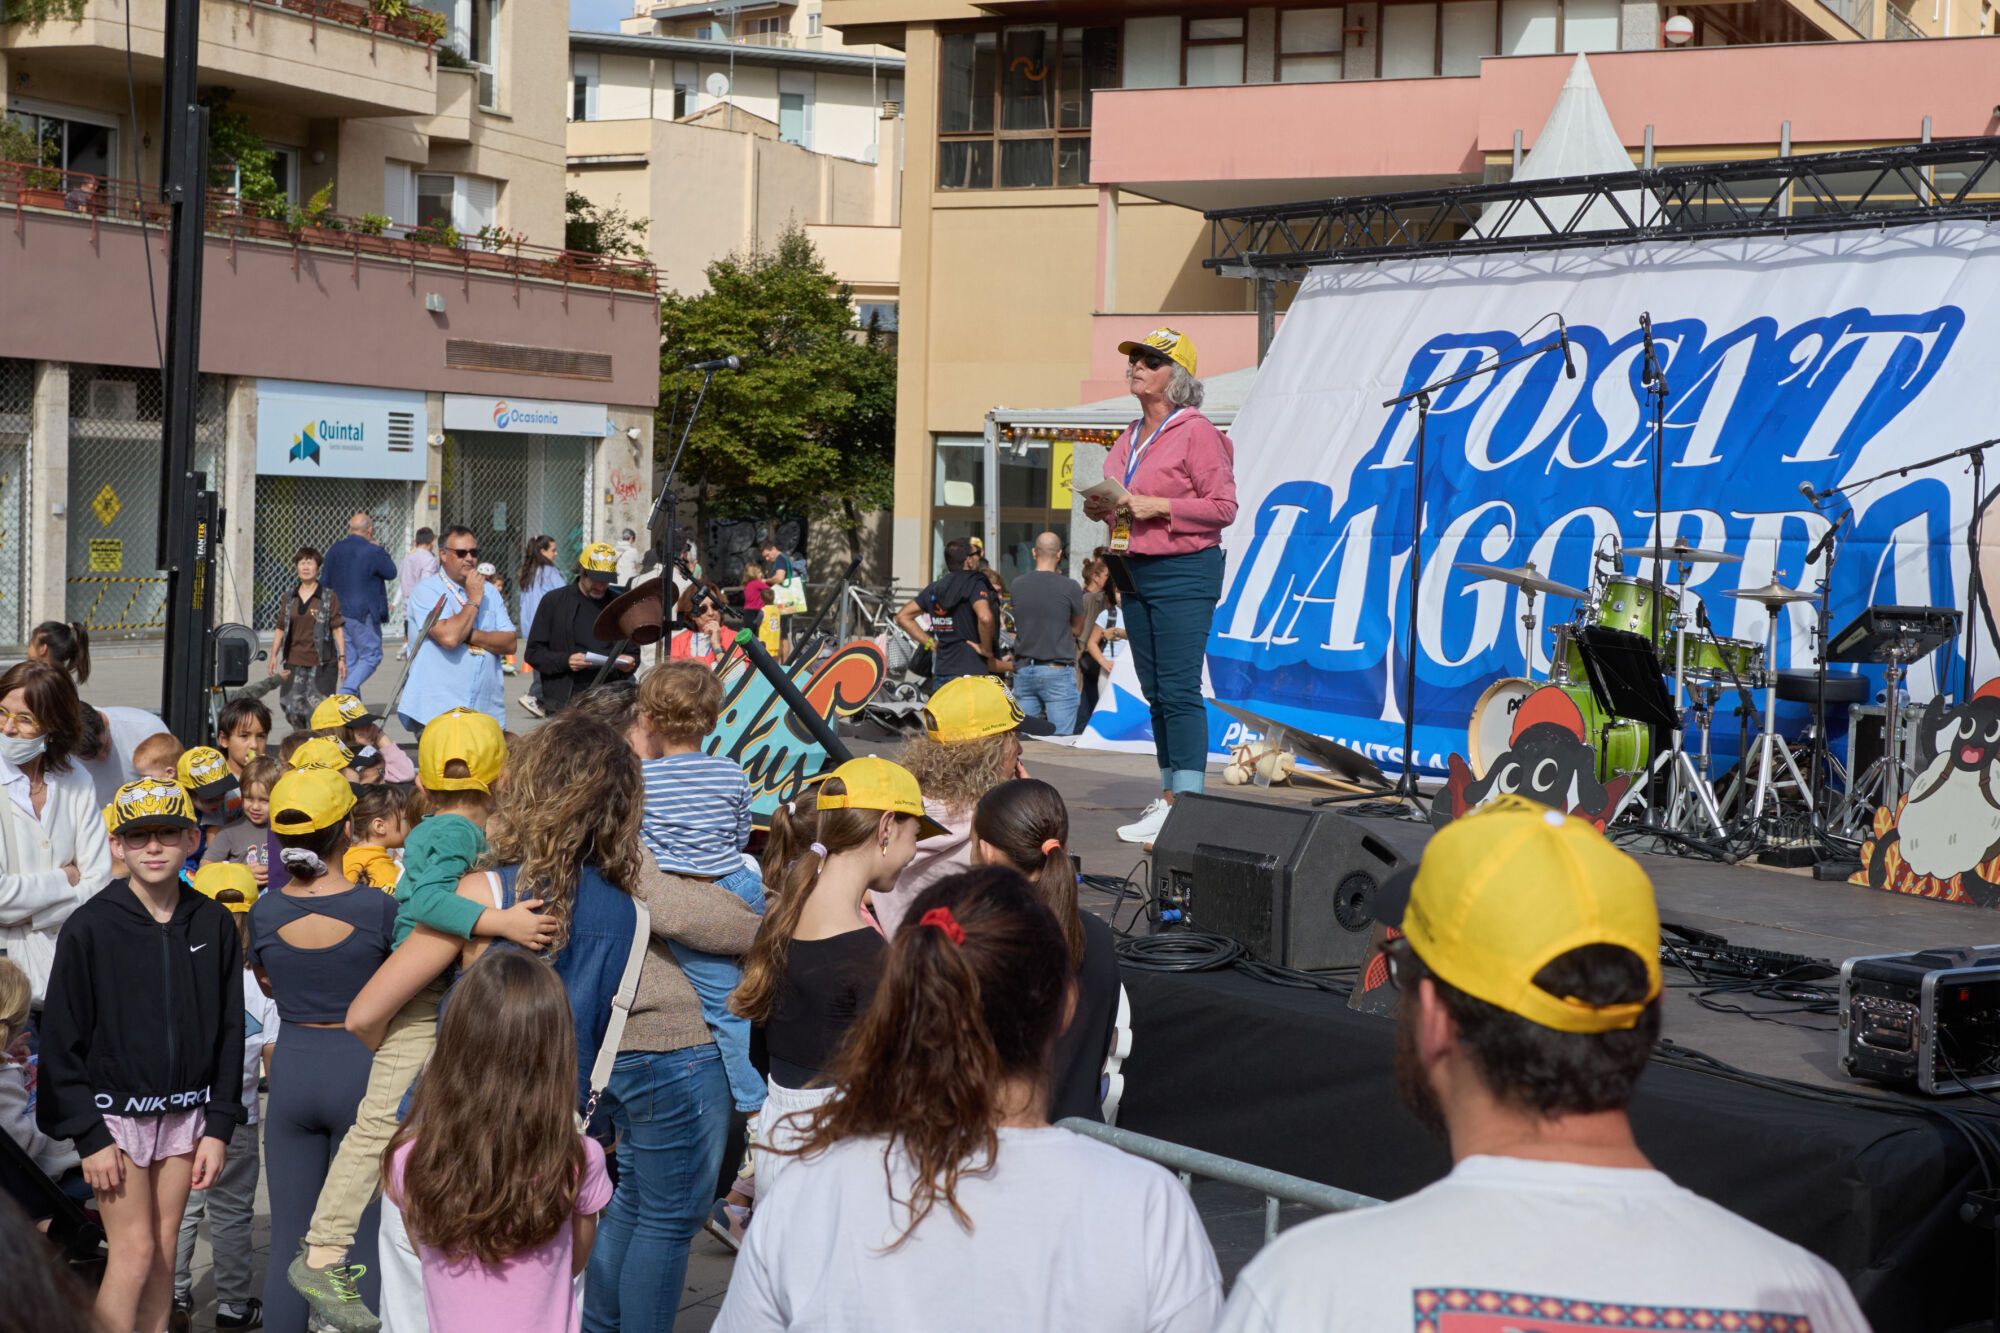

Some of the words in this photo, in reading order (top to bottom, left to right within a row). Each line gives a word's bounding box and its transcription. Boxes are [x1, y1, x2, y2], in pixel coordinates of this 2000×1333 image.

[1368, 318, 1948, 476] POSA'T
[510, 408, 558, 425] Ocasionia
[319, 419, 364, 442] Quintal
[196, 523, 207, 555] FANTEK
[1216, 502, 1378, 654] LA
[124, 1096, 168, 1112] NIK
